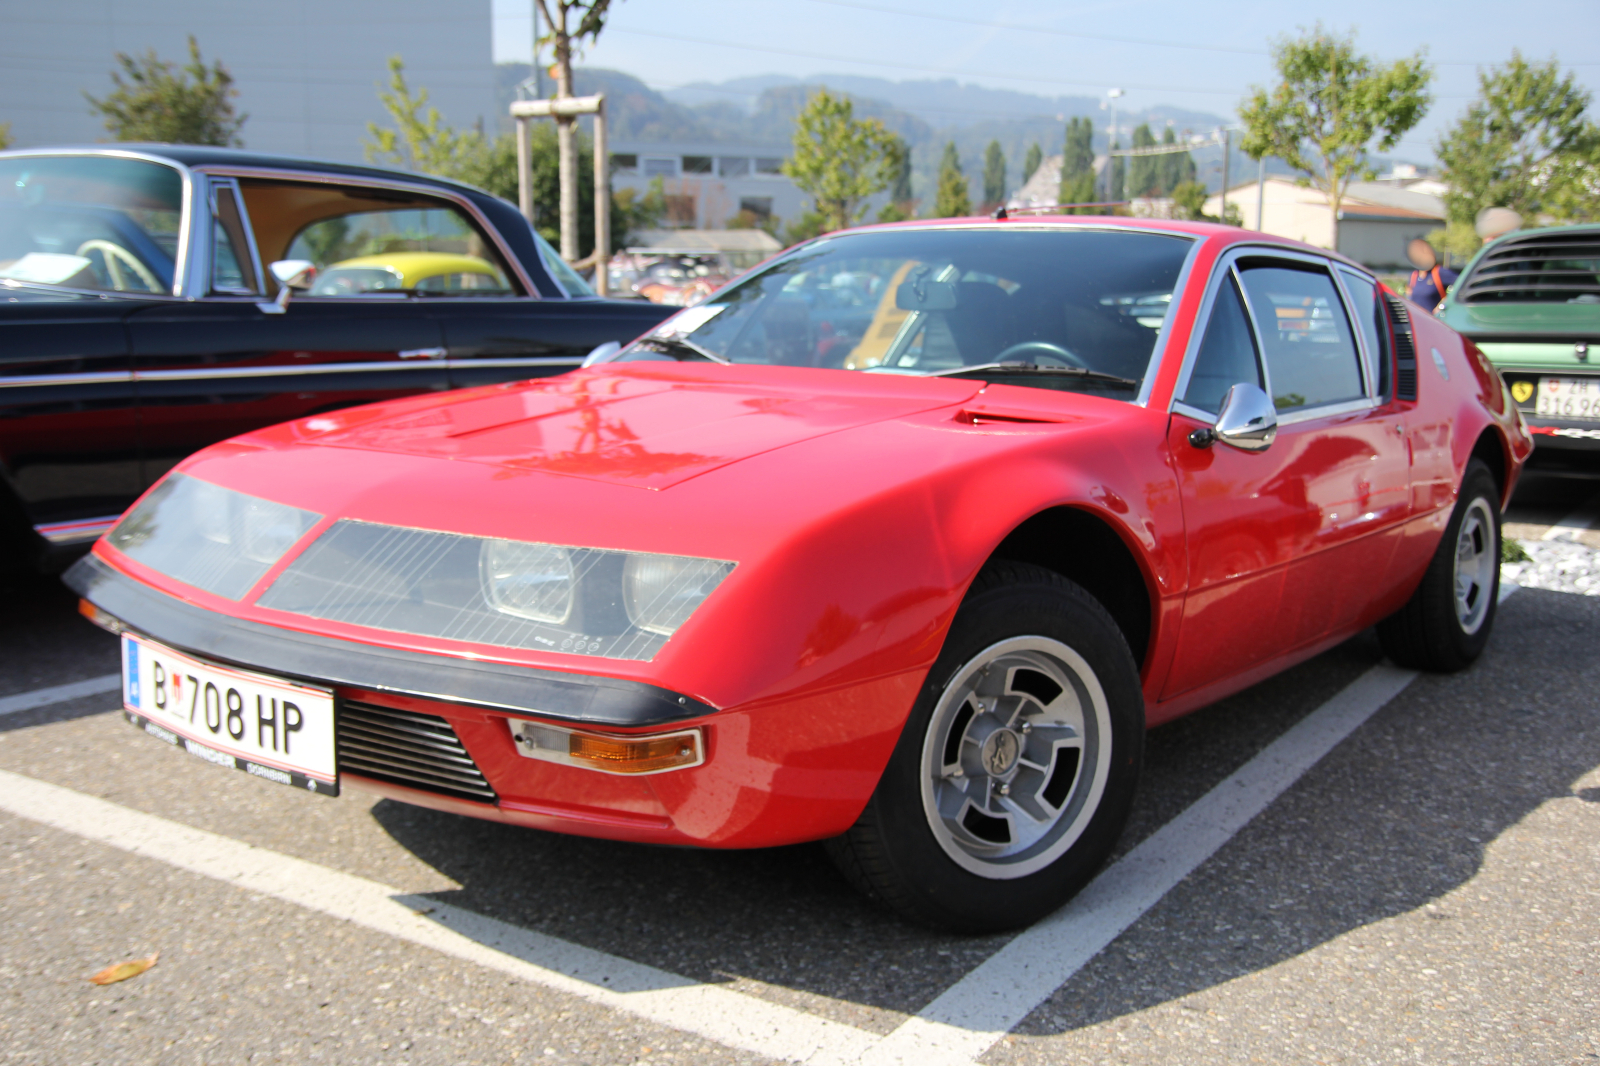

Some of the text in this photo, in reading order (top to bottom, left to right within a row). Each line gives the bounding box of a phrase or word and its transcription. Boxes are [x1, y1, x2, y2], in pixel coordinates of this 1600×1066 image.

[153, 660, 303, 754] B 708 HP
